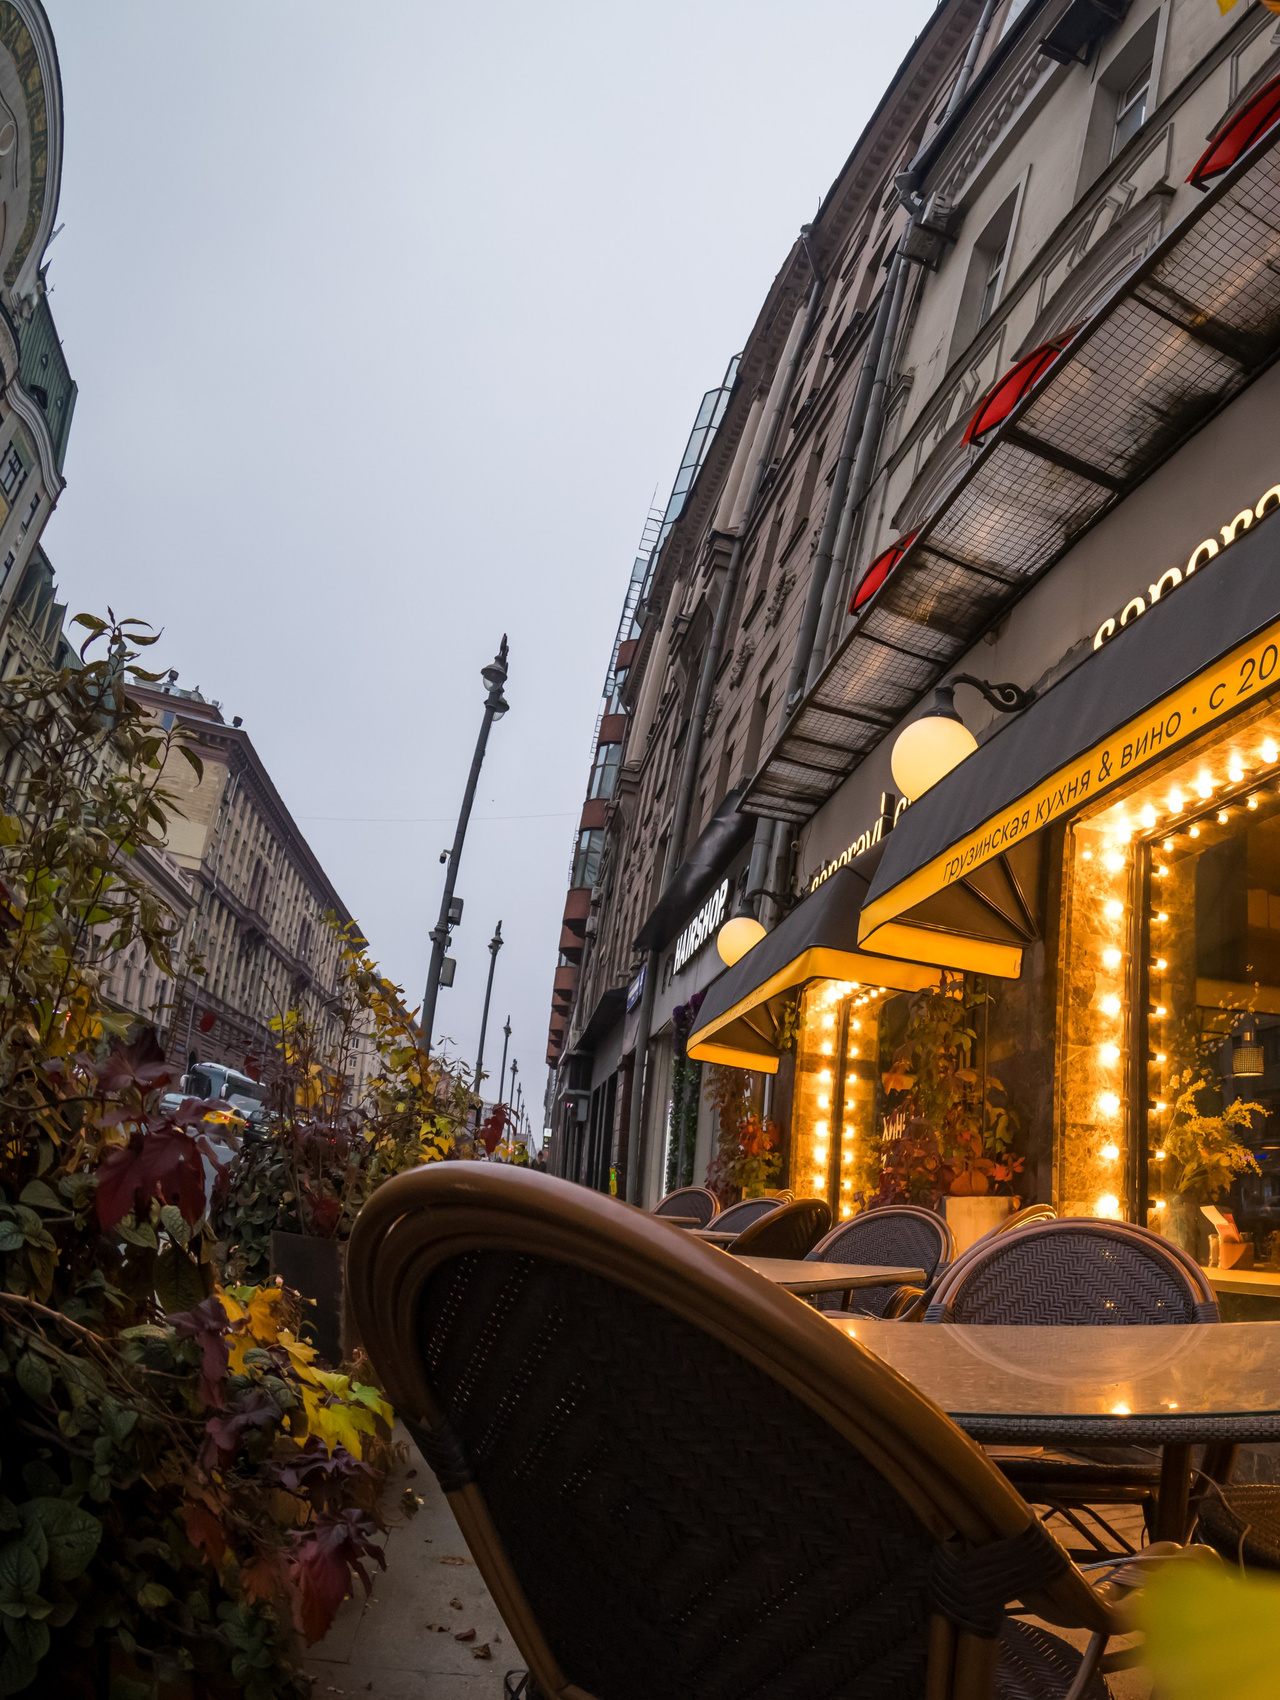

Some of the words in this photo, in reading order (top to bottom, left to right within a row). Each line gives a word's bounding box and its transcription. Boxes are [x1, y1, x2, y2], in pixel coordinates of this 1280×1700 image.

[943, 810, 1030, 883] грузинская
[1035, 770, 1090, 824] кухня
[1098, 750, 1114, 782] &
[1120, 711, 1182, 769] вино
